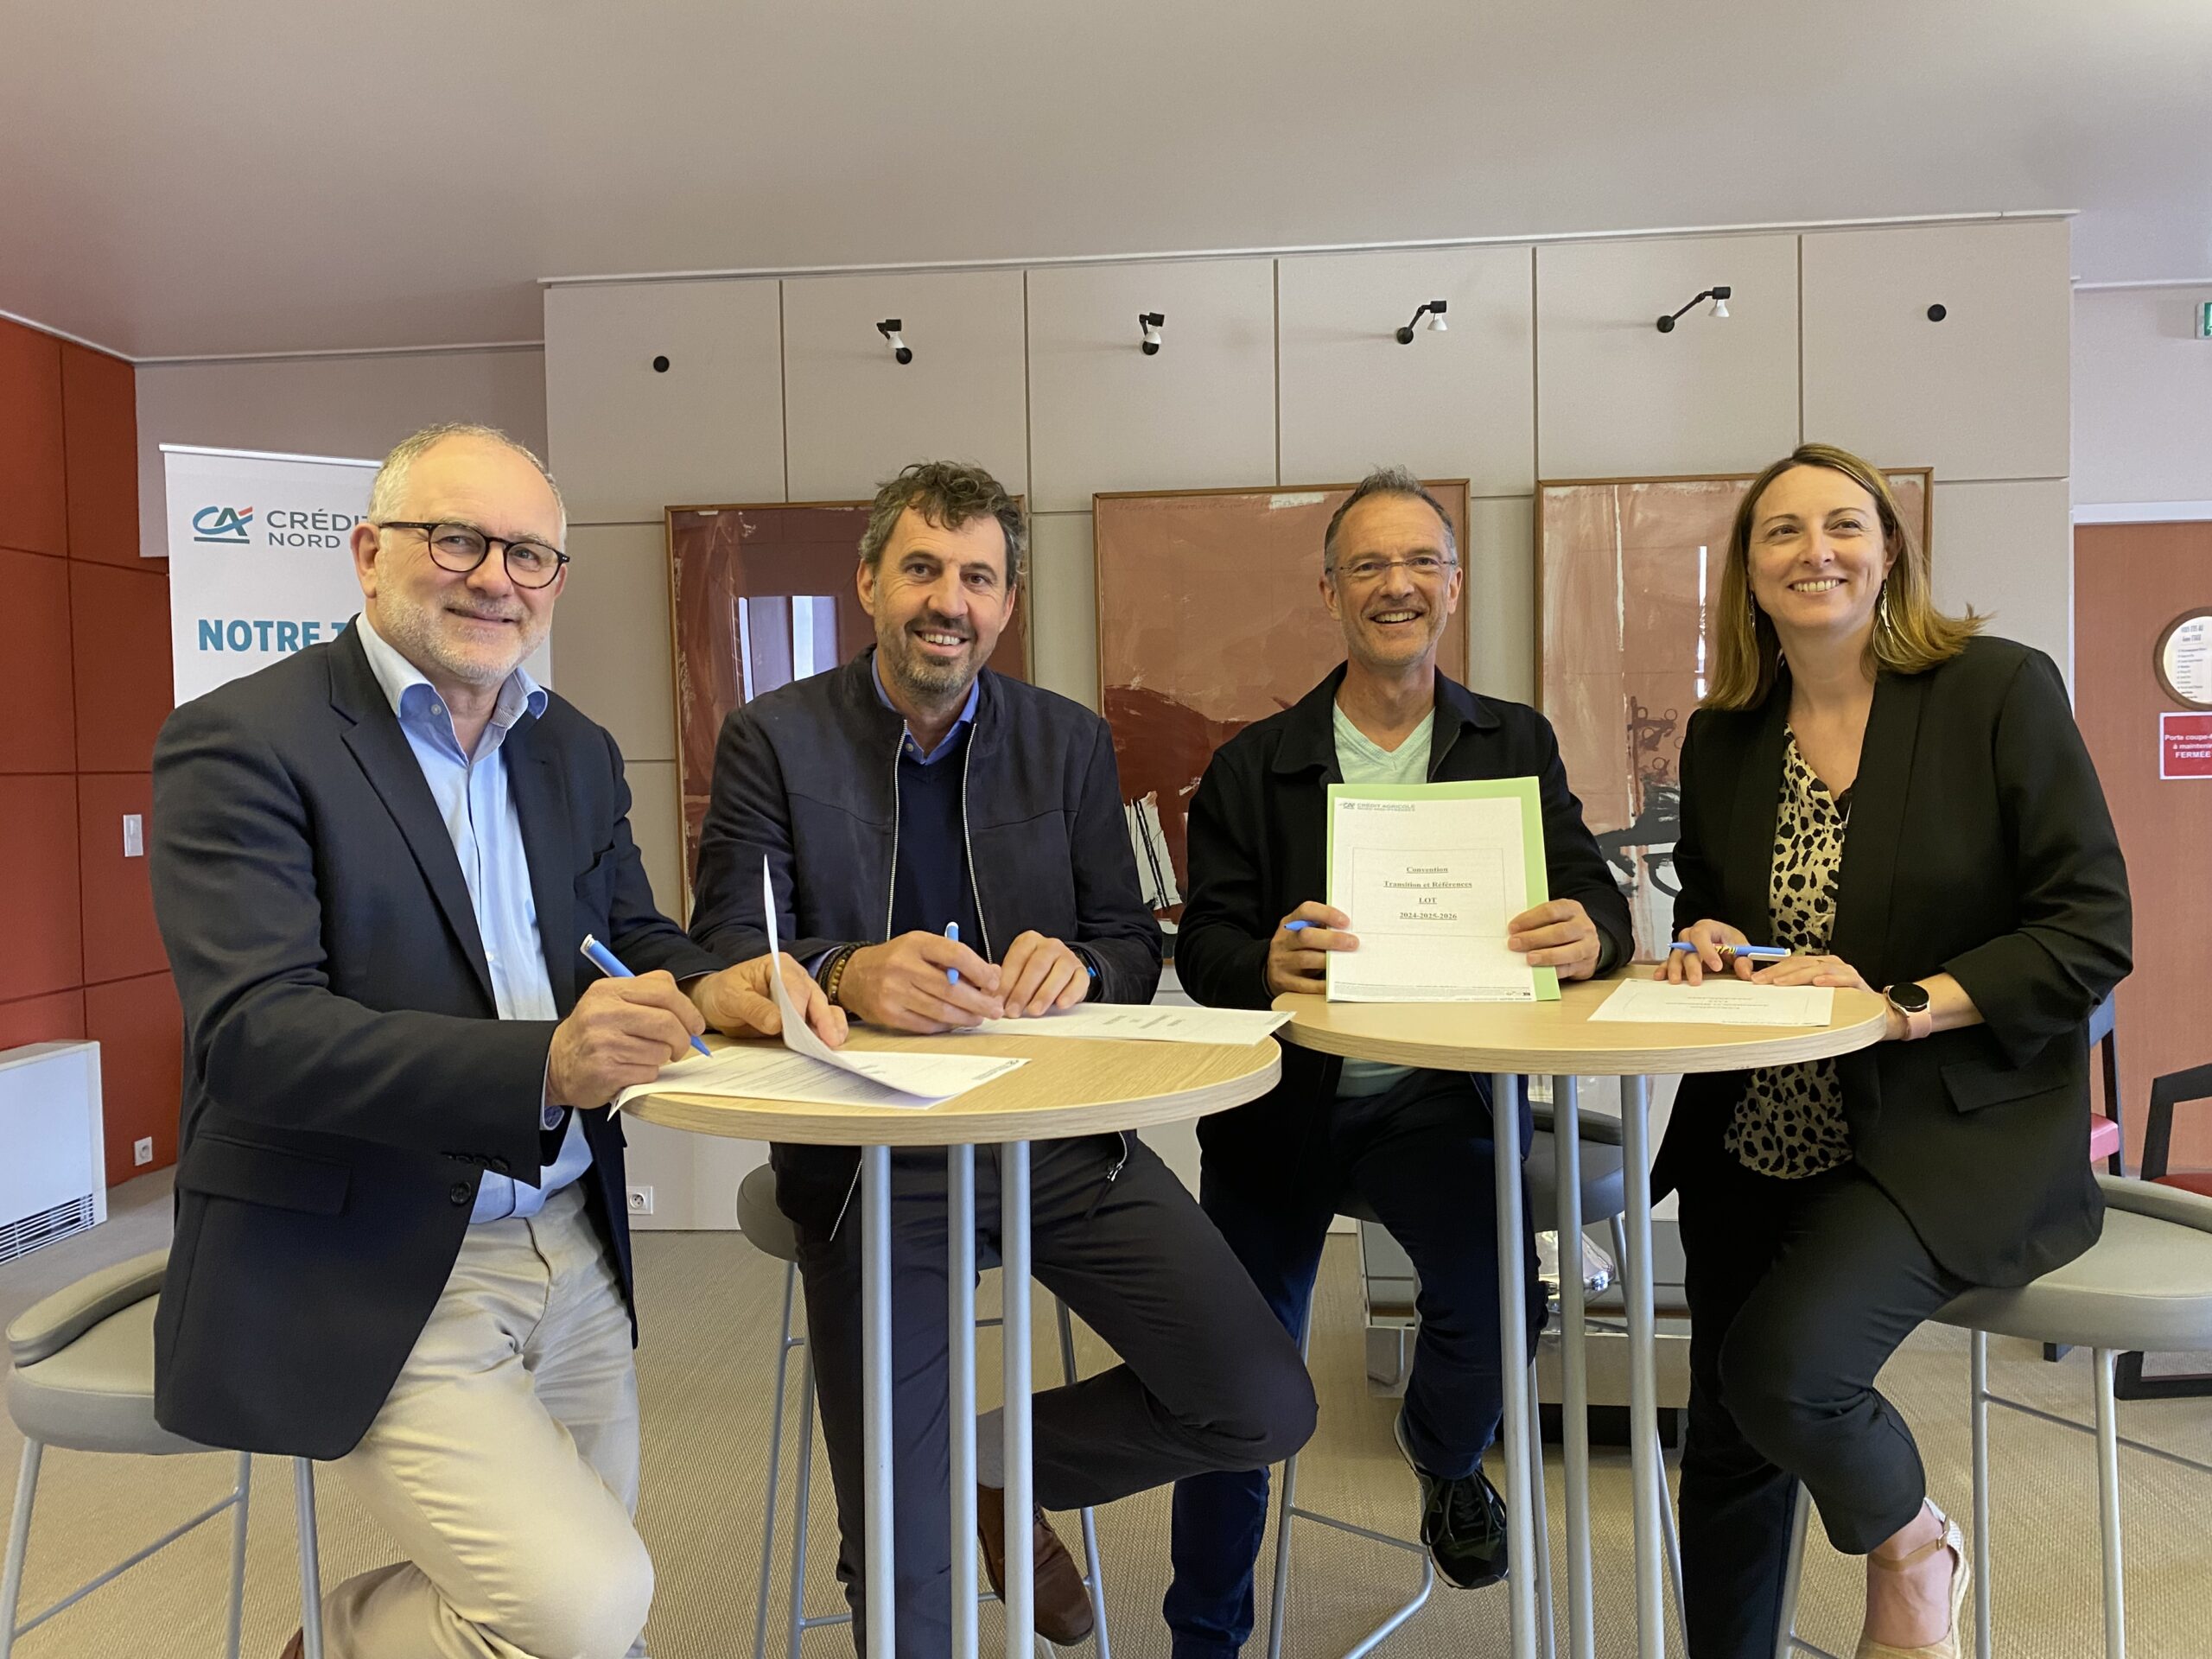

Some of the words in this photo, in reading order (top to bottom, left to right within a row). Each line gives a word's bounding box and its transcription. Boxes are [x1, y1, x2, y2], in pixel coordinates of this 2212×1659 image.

[266, 509, 368, 532] CRÉDI
[269, 532, 341, 549] NORD
[198, 619, 321, 652] NOTRE
[1383, 880, 1421, 889] Transition
[1399, 912, 1458, 920] 2024-2025-2026
